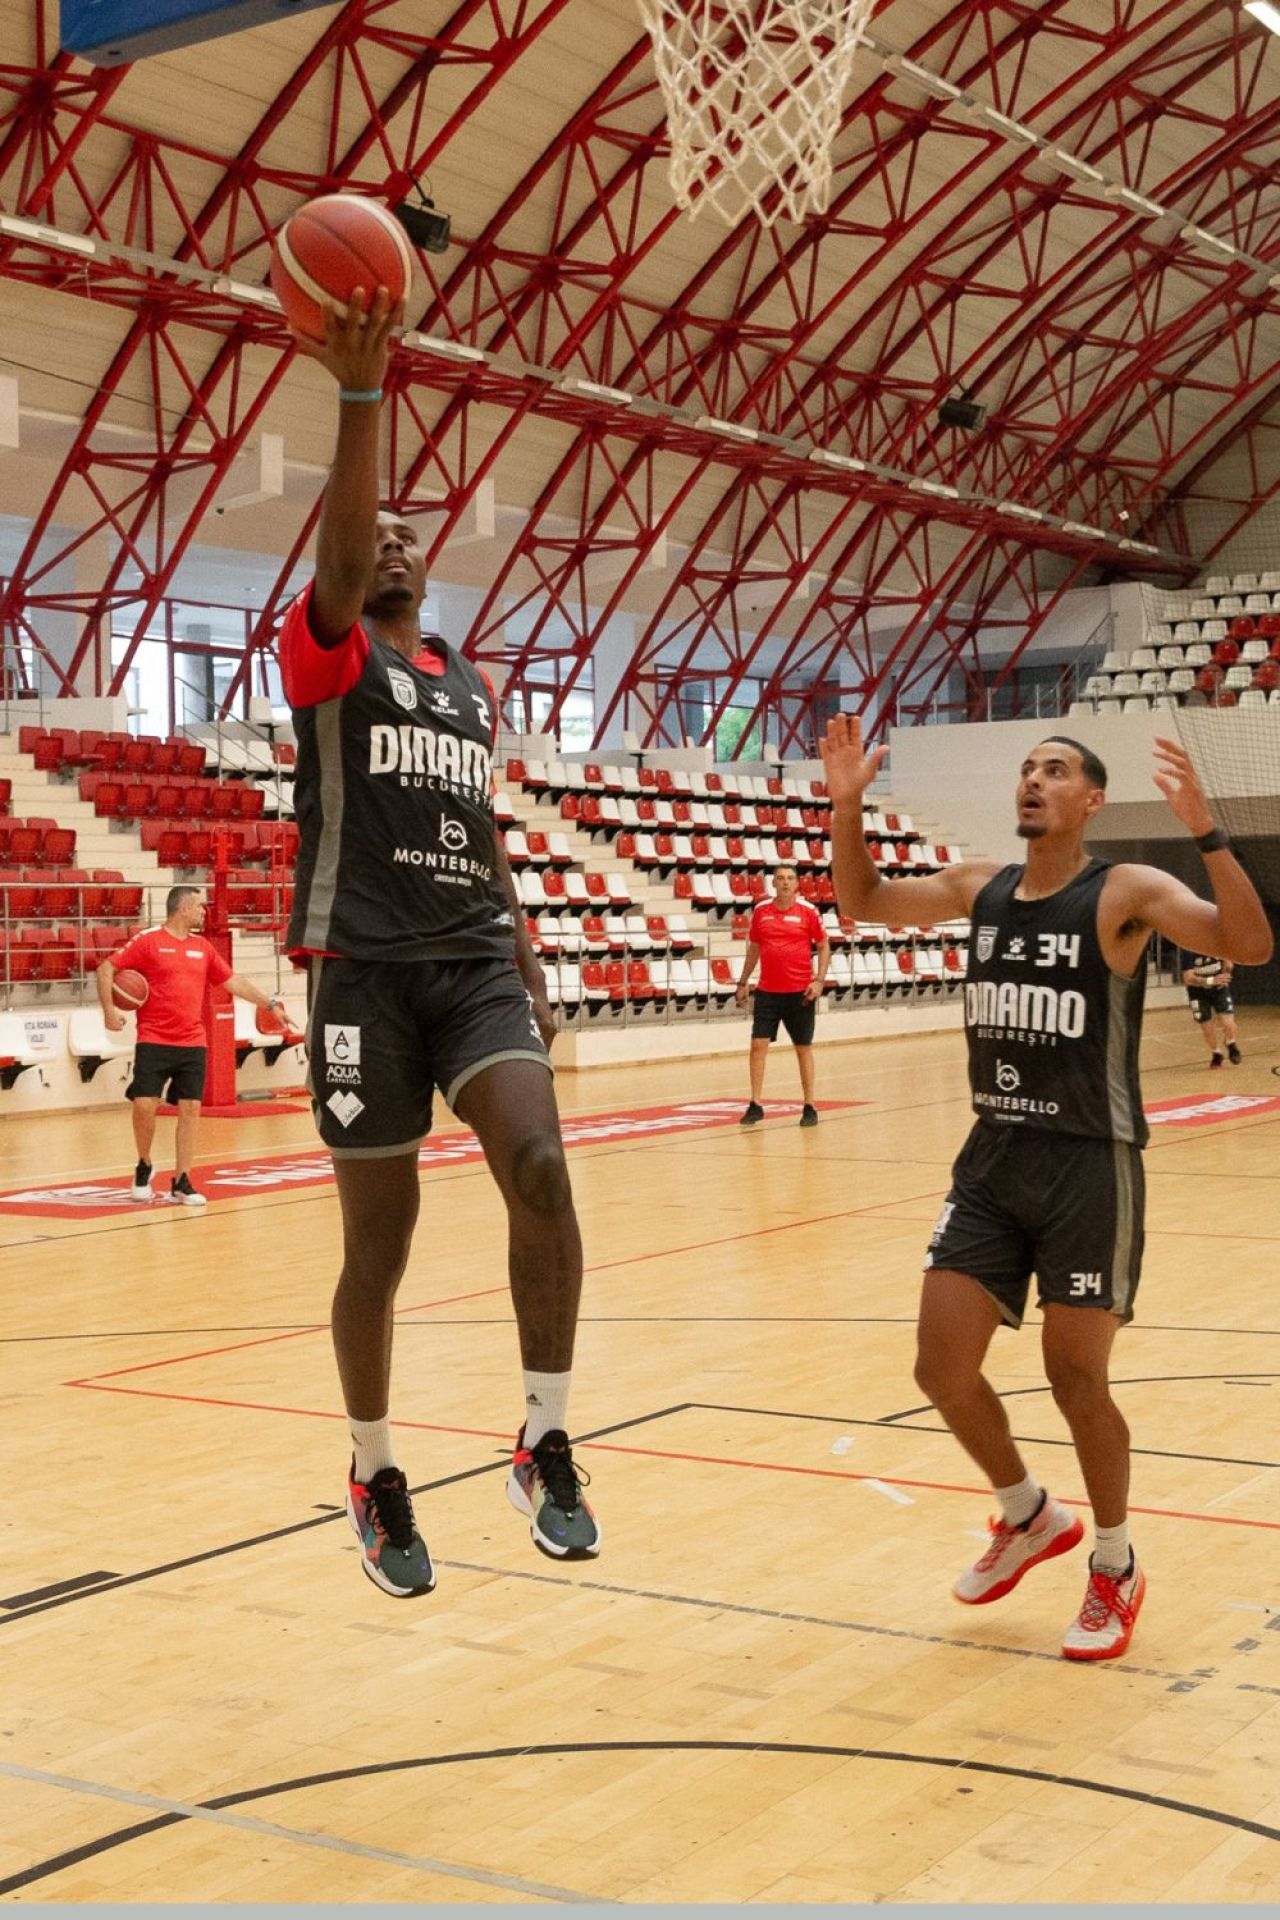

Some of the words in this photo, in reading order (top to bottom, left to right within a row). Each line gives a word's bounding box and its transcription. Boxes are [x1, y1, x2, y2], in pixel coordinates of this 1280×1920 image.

[430, 704, 460, 717] KELME
[369, 725, 492, 798] DINAM
[1035, 933, 1081, 968] 34
[966, 981, 1086, 1039] DINAMO
[326, 1065, 361, 1080] AQUA
[1069, 1272, 1102, 1296] 34
